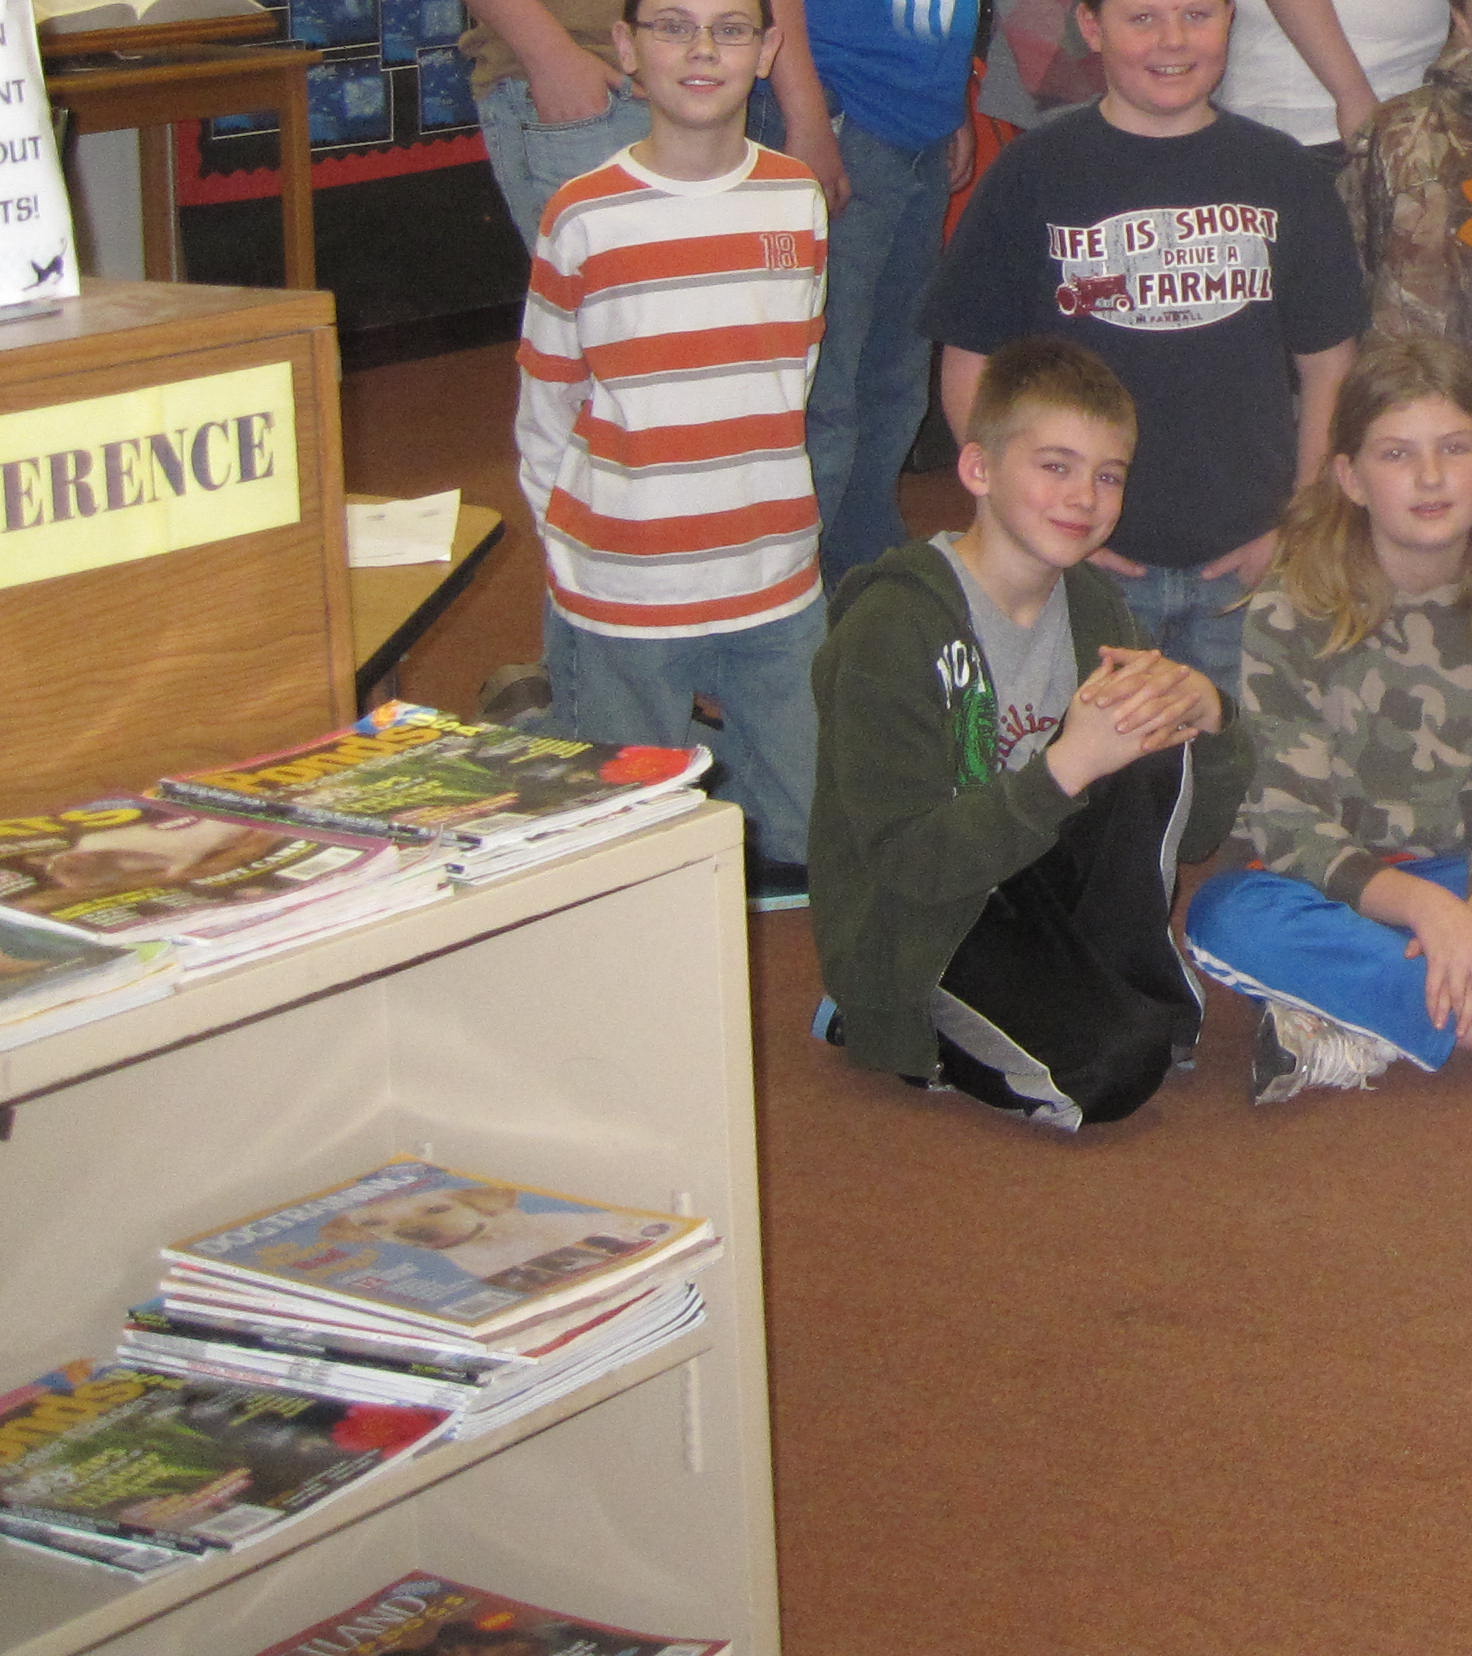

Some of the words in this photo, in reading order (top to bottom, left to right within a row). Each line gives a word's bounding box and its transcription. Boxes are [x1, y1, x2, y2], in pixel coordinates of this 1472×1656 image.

[760, 233, 799, 271] 18
[1048, 224, 1106, 261] LIFE
[1124, 218, 1158, 255] IS
[1174, 204, 1279, 243] SHORT
[1162, 246, 1217, 268] DRIVE
[1225, 244, 1242, 266] A
[1136, 267, 1273, 308] FARMALL
[0, 411, 275, 535] ERENCE
